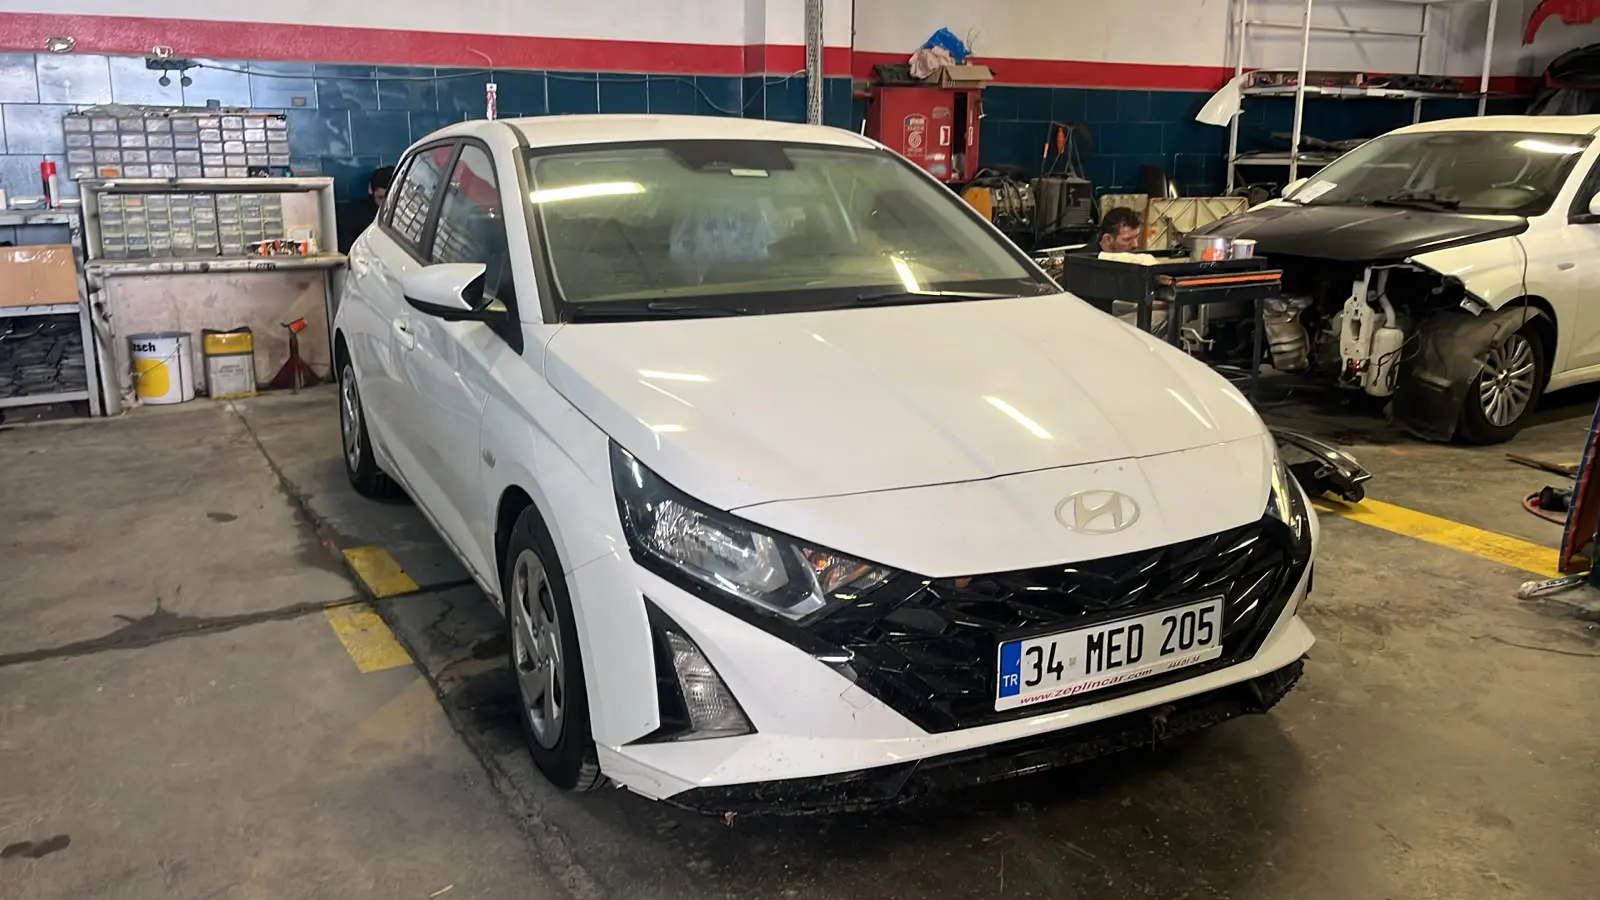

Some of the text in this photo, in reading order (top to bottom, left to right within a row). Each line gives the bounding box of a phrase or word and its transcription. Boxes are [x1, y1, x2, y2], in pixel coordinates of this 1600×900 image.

[1025, 606, 1215, 687] 34 MED 205
[1003, 673, 1018, 688] TR
[1020, 669, 1153, 705] www.zeplincar.com
